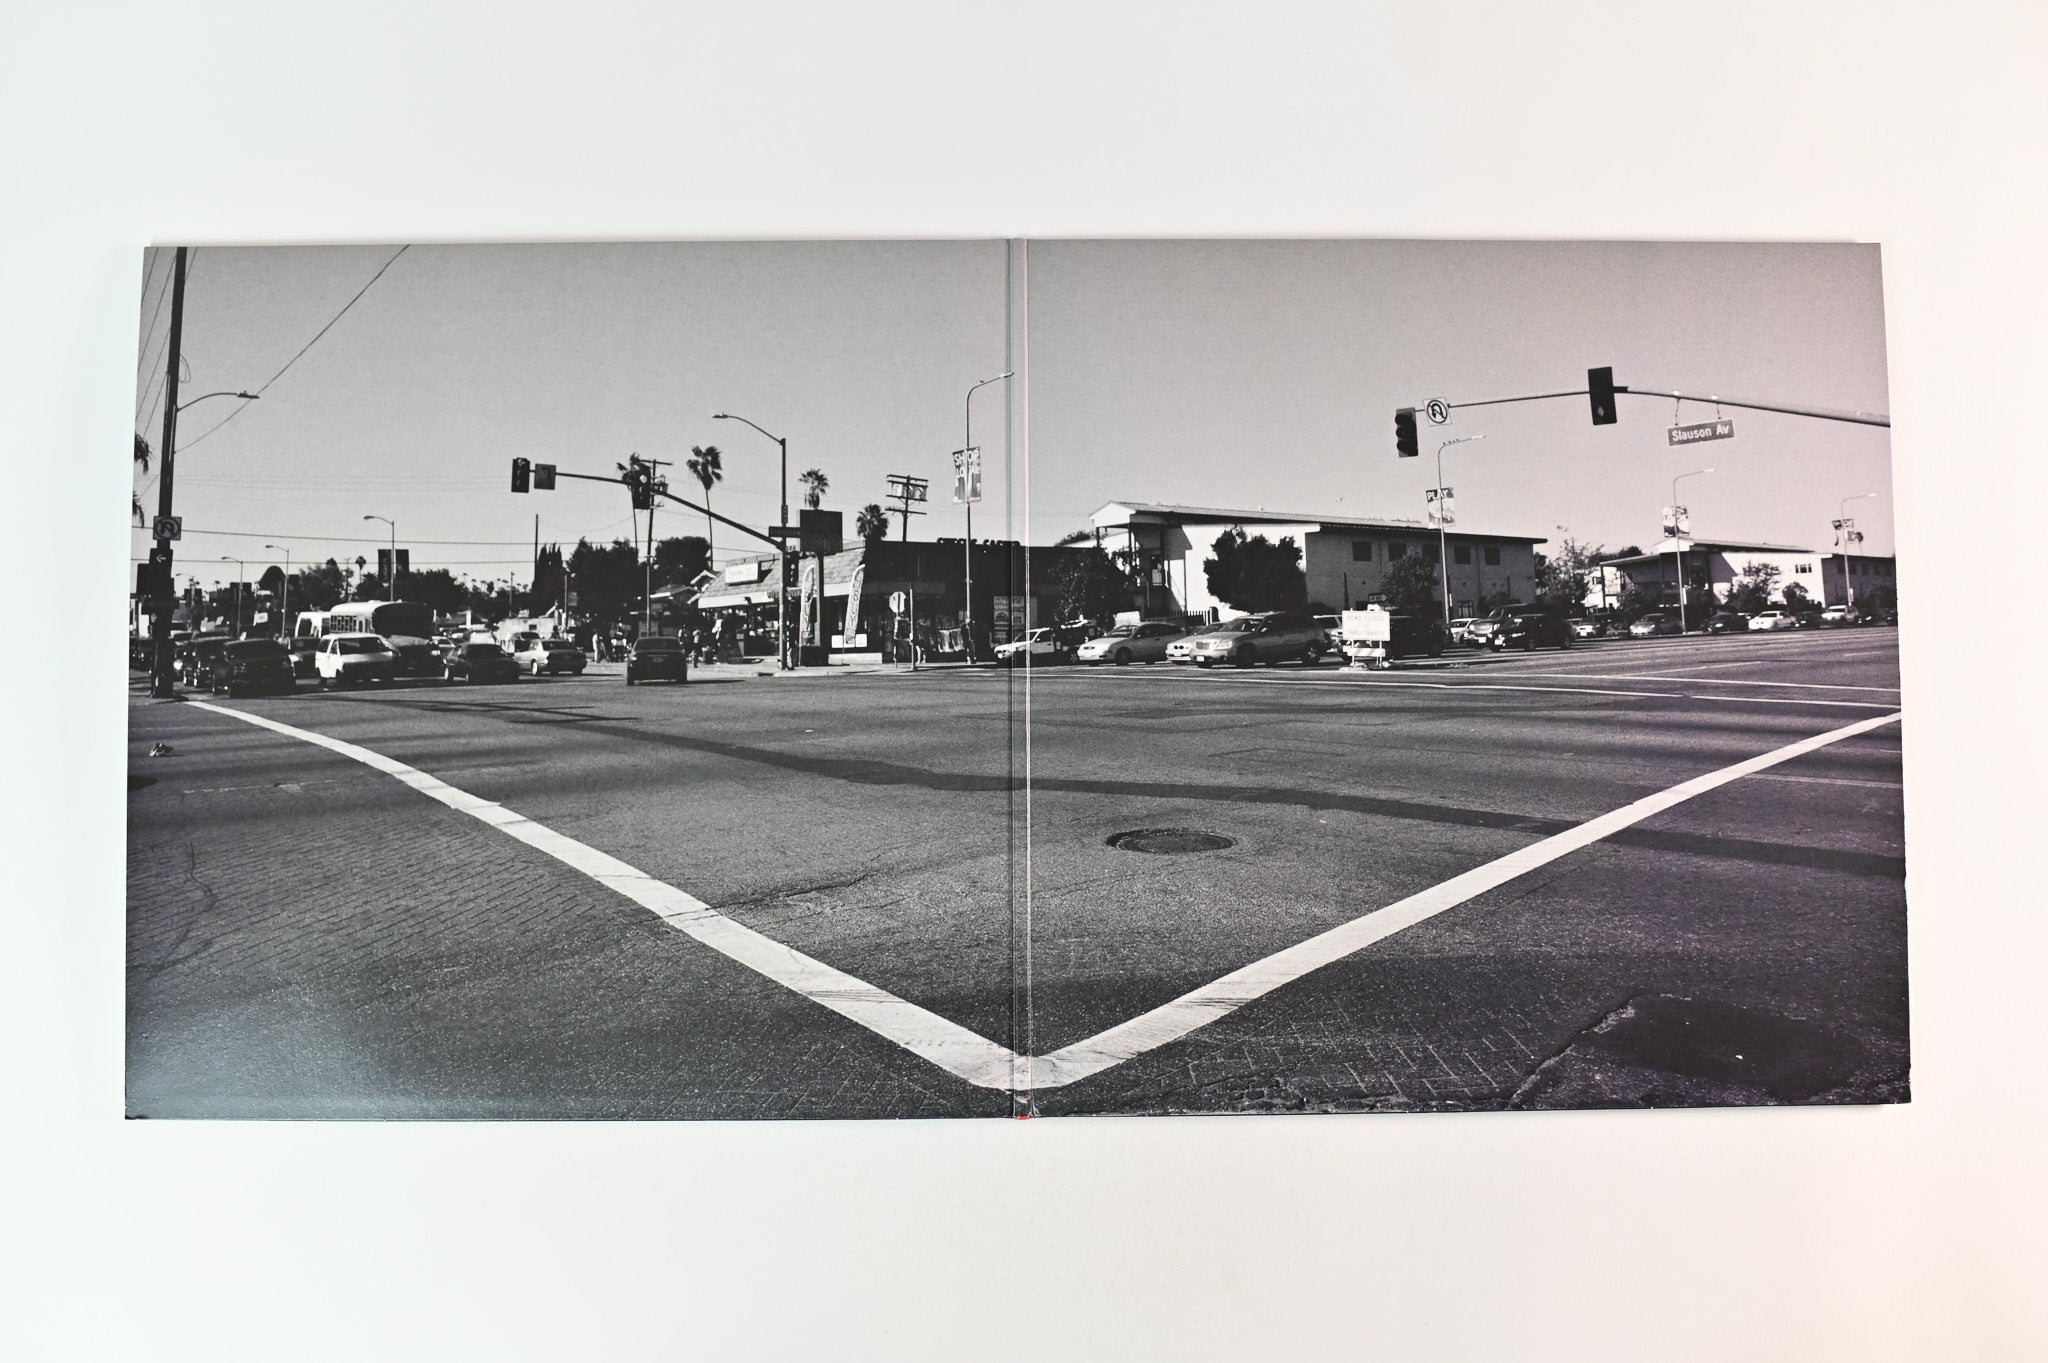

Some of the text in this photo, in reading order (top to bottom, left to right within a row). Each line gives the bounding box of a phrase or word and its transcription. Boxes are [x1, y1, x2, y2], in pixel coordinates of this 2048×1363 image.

[1671, 424, 1729, 442] Slauson Av
[954, 449, 980, 466] SHOP
[1427, 489, 1448, 501] PLAY
